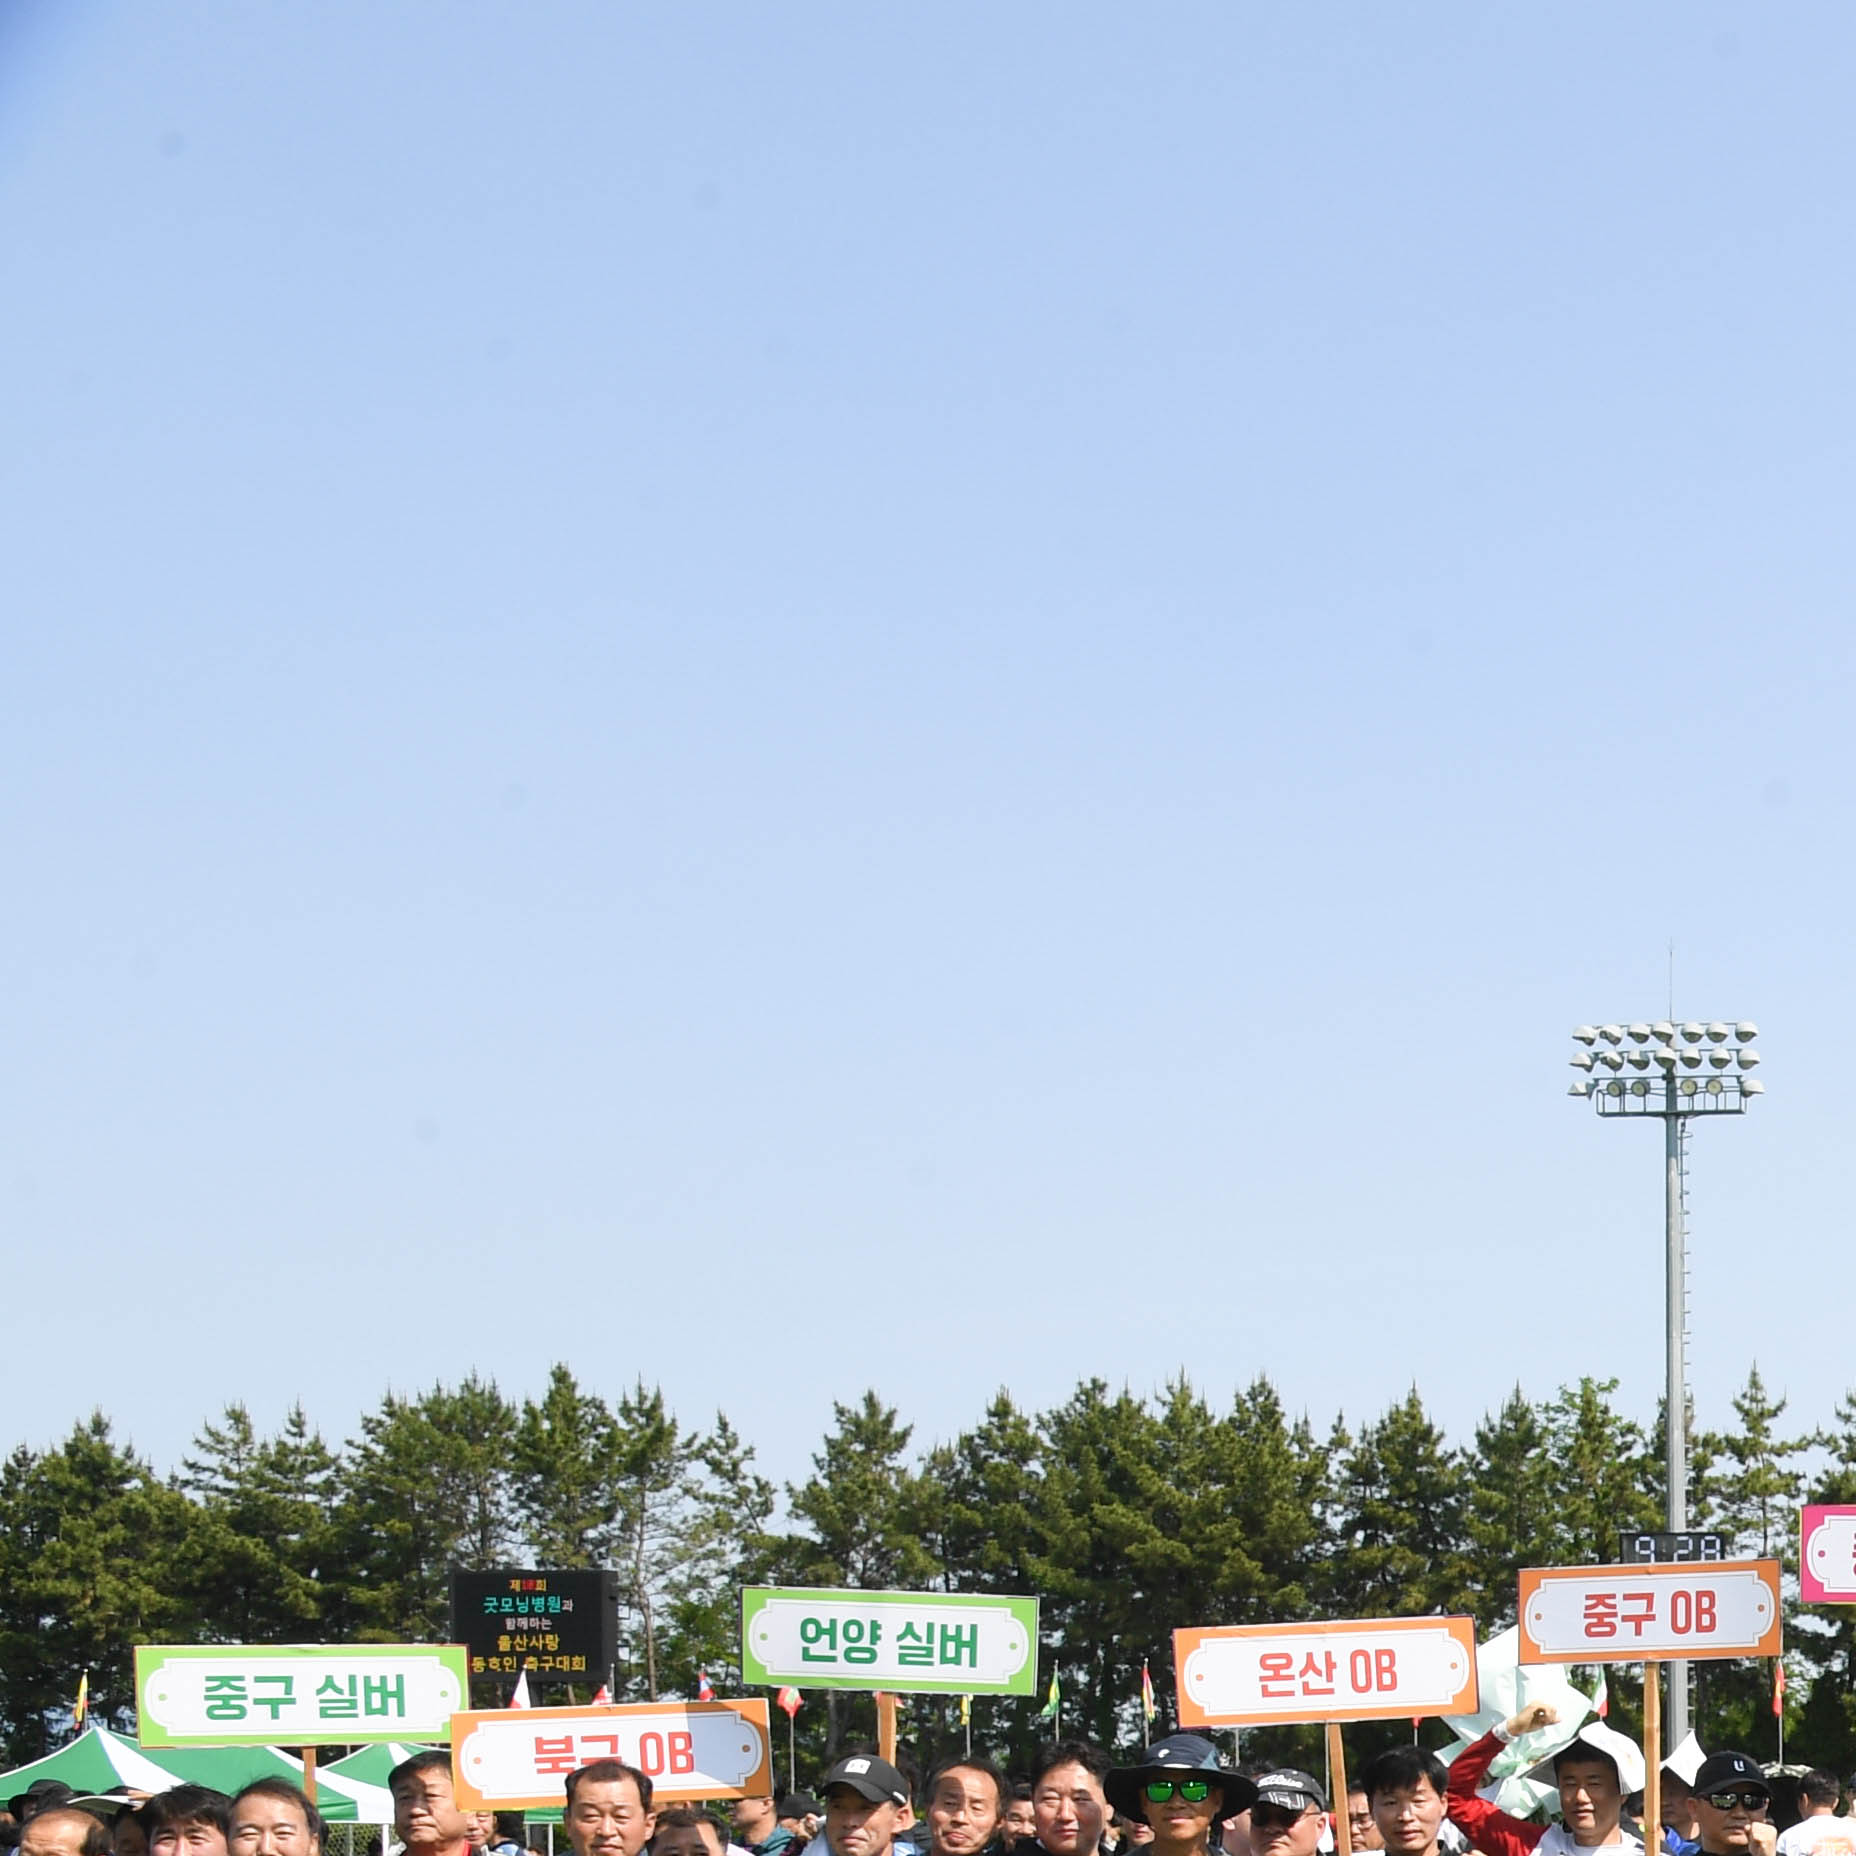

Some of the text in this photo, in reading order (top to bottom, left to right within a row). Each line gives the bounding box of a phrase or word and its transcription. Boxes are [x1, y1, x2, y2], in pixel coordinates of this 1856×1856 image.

[505, 1617, 552, 1630] 함께하는
[1584, 1591, 1716, 1637] 중구 OB
[471, 1656, 586, 1672] 동호인 축구대회
[497, 1634, 560, 1651] 울산사랑
[800, 1618, 977, 1667] 언양 실버
[1259, 1649, 1397, 1698] 온산 OB
[204, 1674, 405, 1720] 중구 실버
[535, 1731, 695, 1776] 북구 OB
